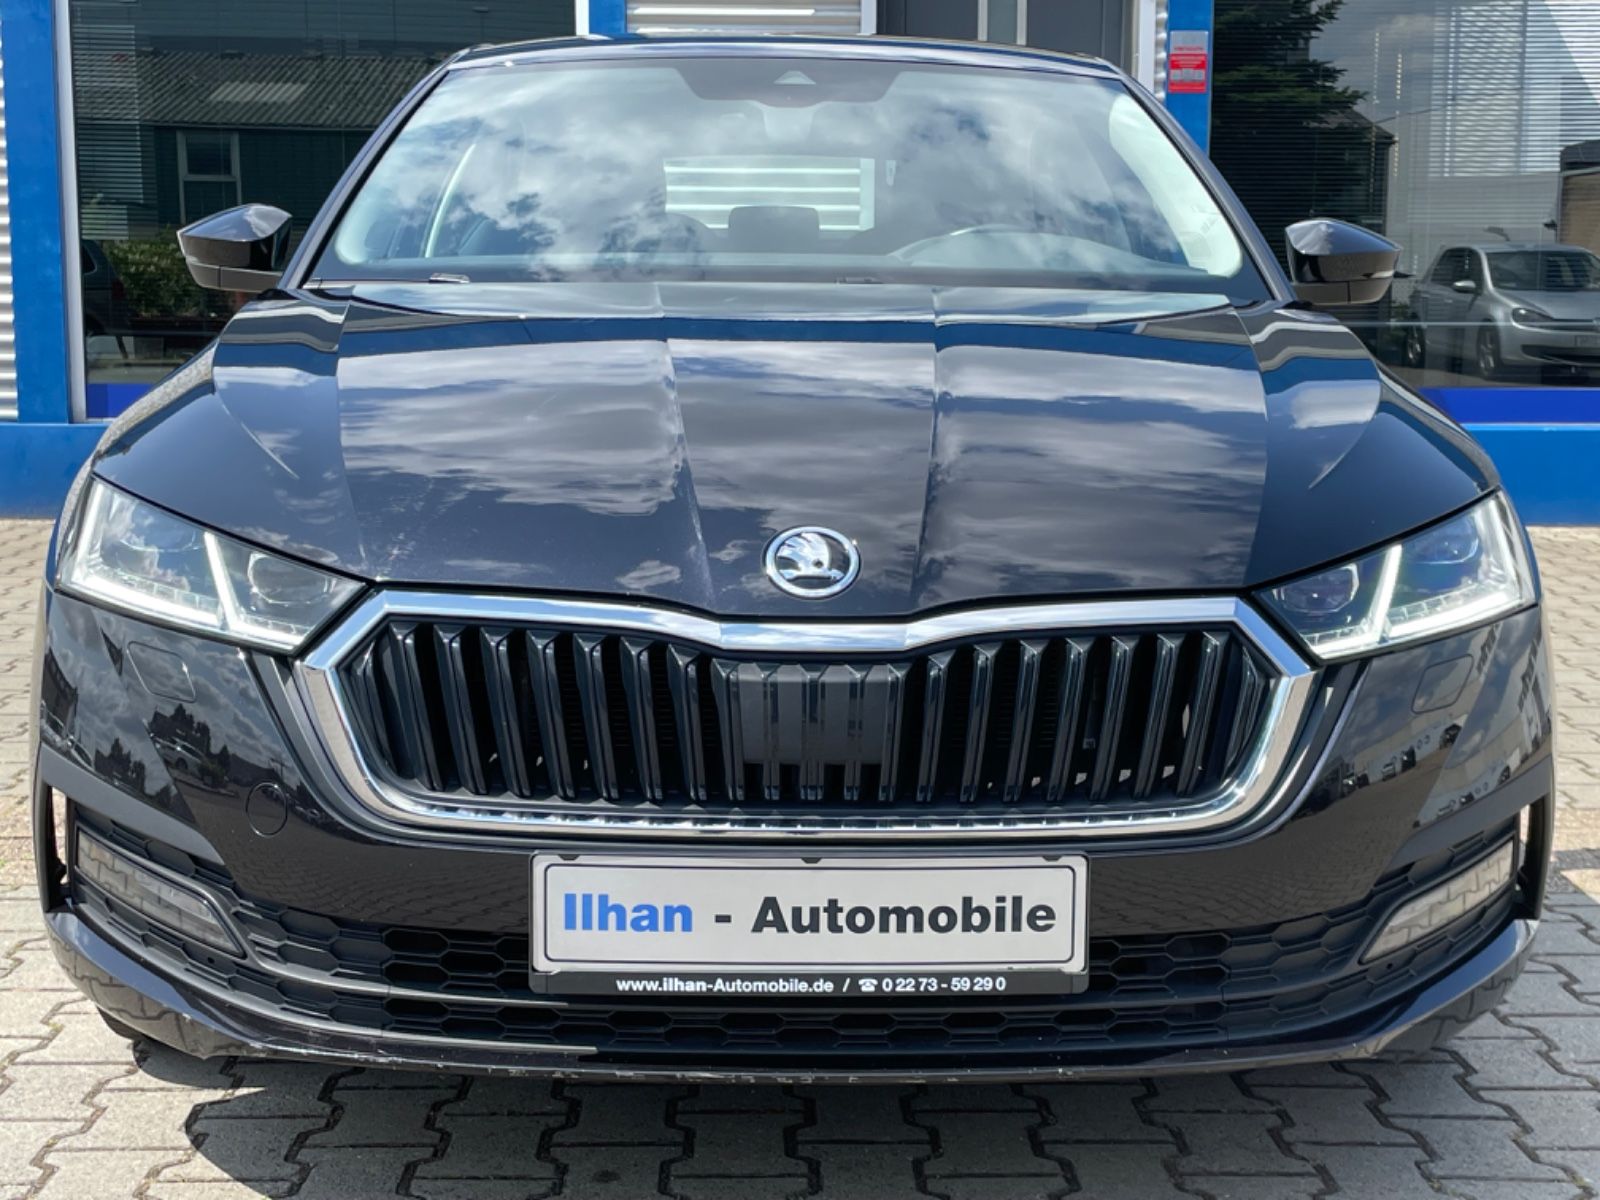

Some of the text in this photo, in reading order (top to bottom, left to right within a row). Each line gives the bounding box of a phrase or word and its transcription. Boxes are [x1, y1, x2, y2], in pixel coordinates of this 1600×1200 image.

[563, 893, 1057, 935] Ilhan - Automobile
[615, 976, 835, 993] www.ilhan-Automobile.de
